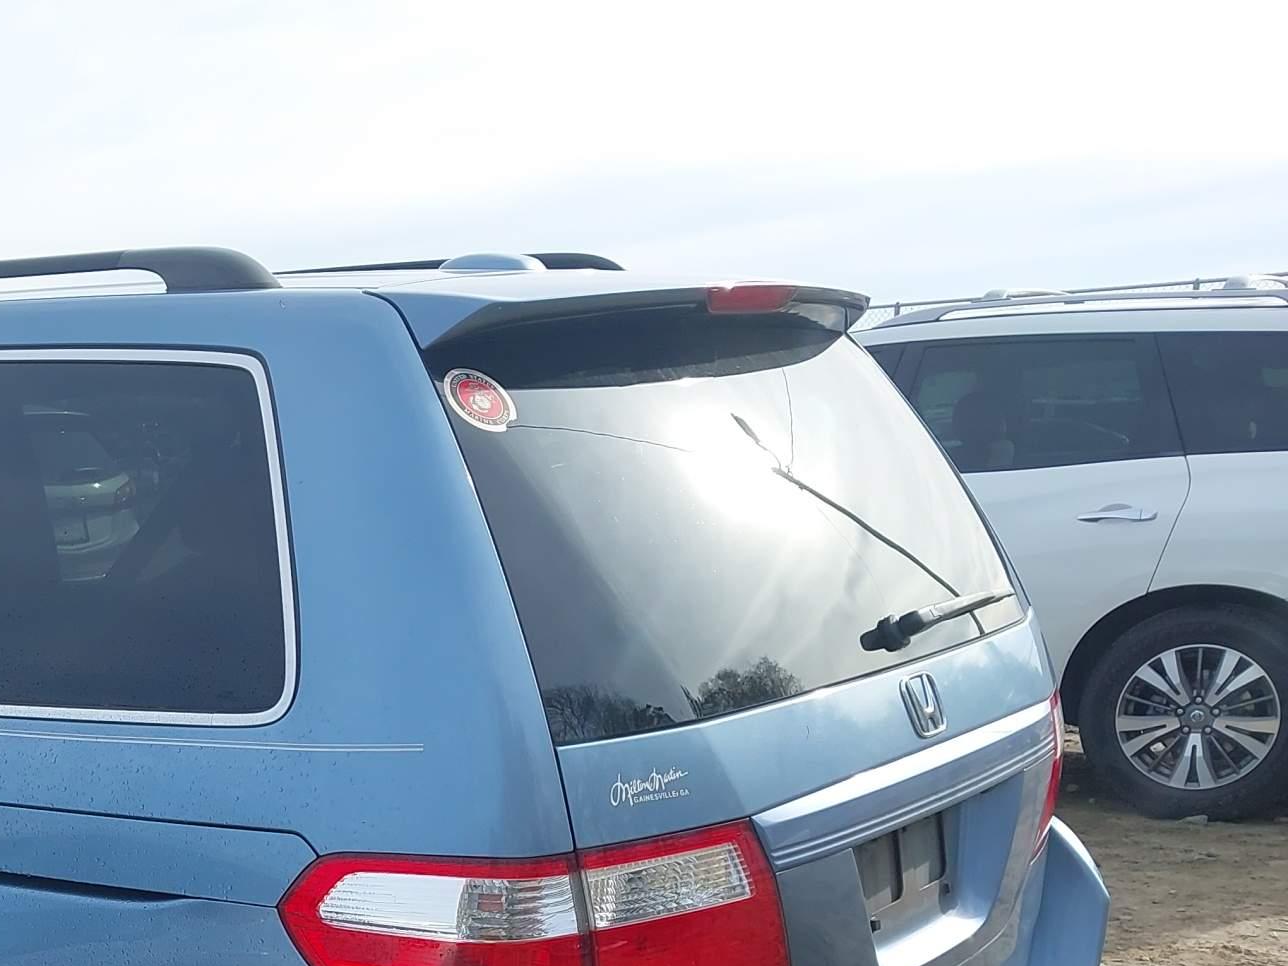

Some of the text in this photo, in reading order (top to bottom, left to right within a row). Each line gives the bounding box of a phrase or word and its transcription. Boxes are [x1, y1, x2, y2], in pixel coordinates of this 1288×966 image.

[610, 767, 689, 807] Milton Martin
[680, 789, 690, 797] GA
